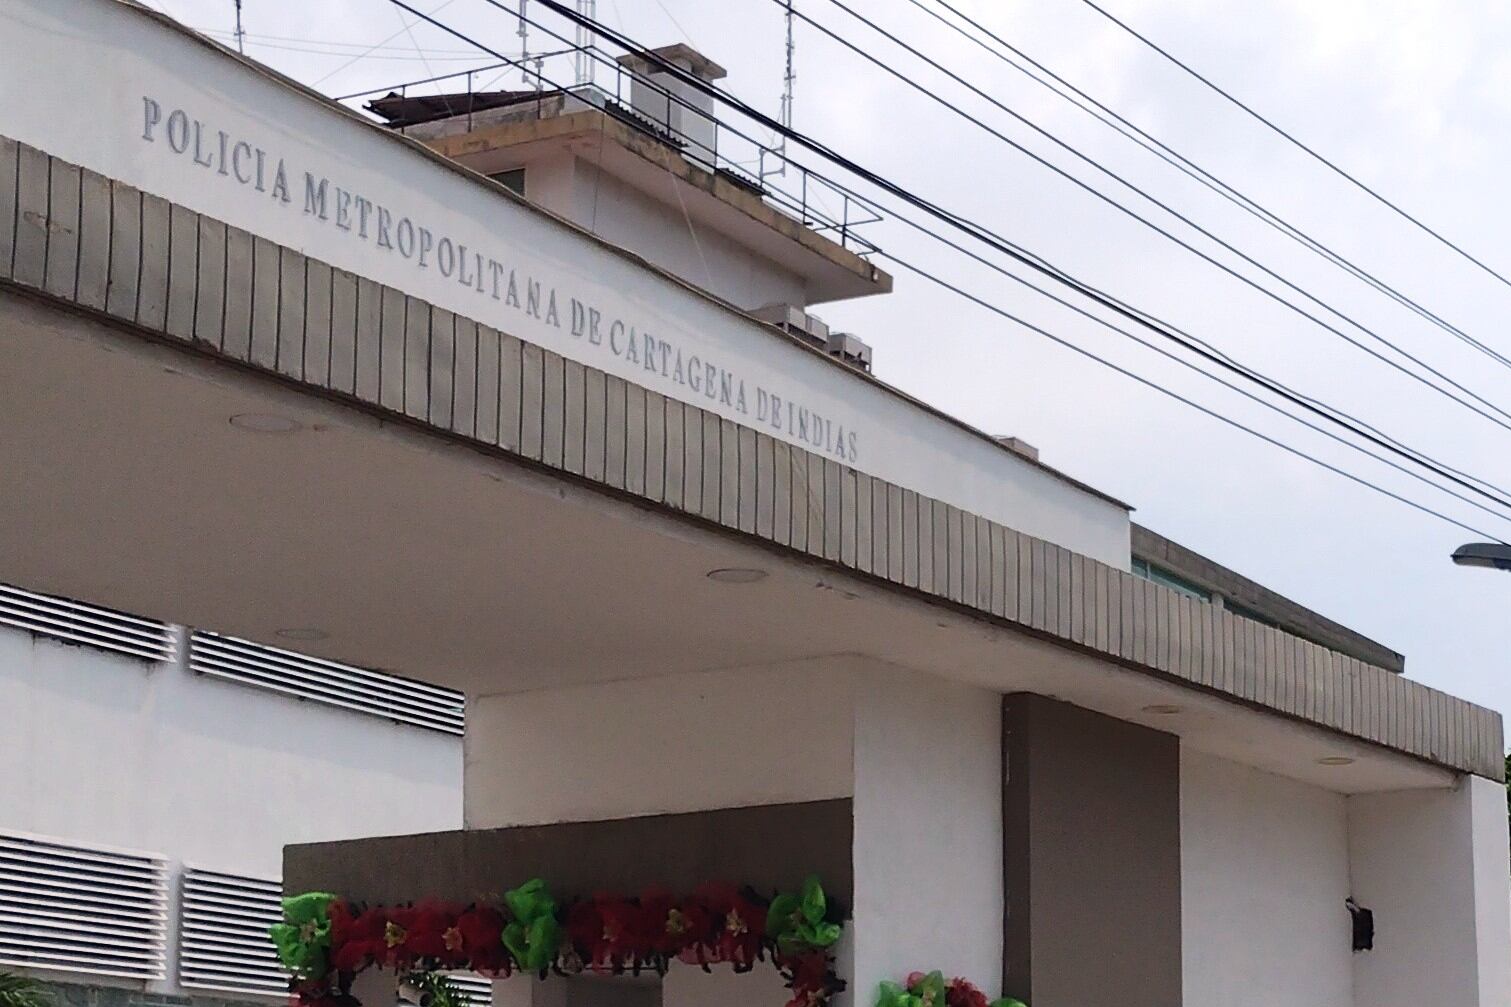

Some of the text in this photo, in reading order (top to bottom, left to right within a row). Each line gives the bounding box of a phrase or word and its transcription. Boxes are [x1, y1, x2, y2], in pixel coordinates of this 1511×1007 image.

[142, 95, 858, 463] POLICIA METROPOLITANA DE CARTAGENA DE INDIAS
